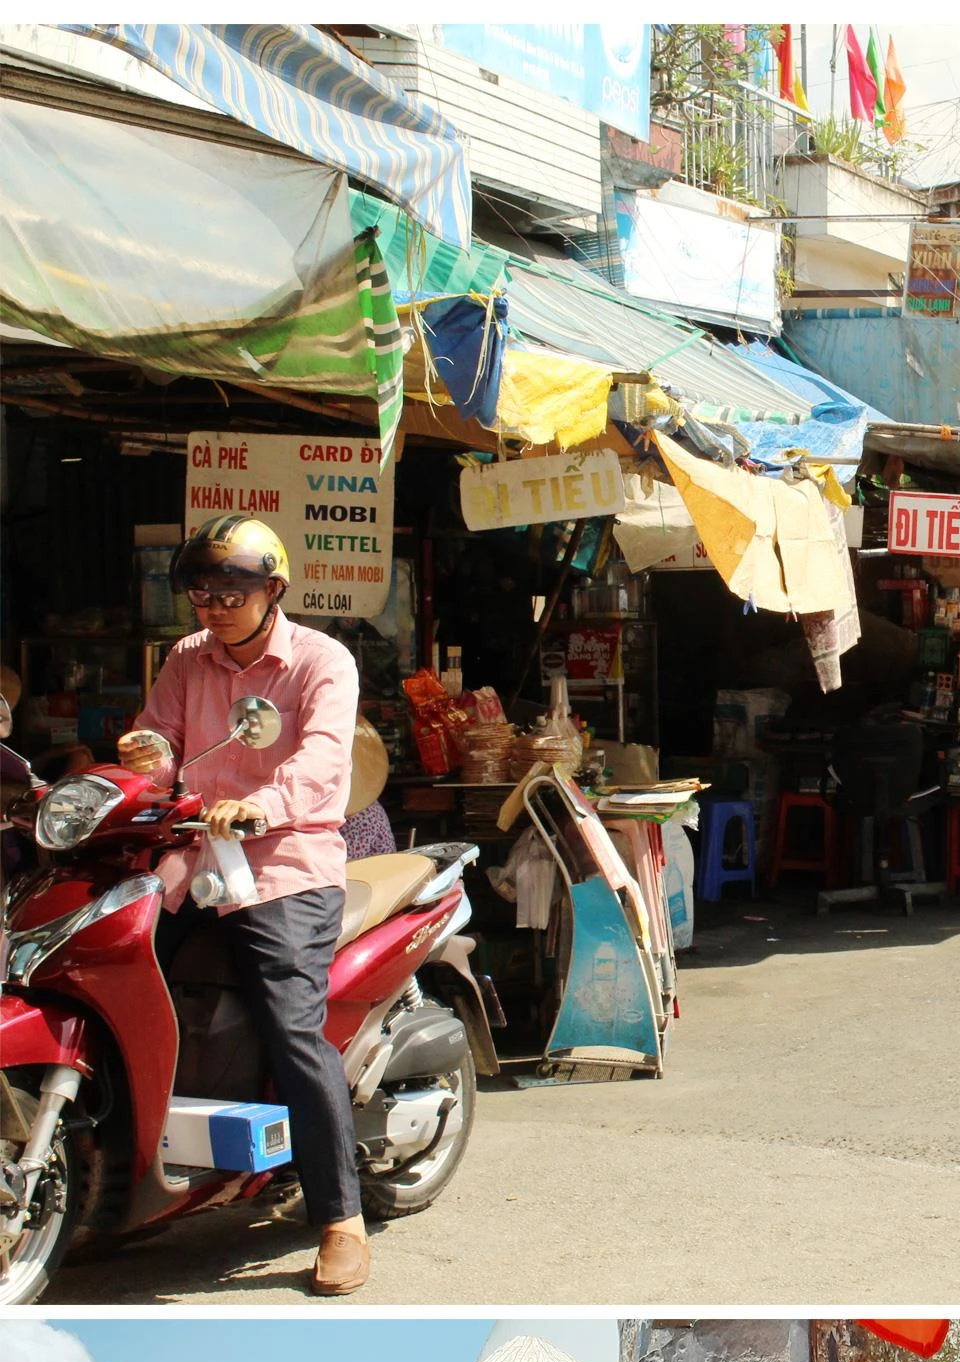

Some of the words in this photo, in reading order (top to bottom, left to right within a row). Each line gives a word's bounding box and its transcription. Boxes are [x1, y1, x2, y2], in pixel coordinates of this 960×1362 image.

[602, 76, 639, 113] pepsi
[192, 440, 212, 468] CÀ
[218, 441, 249, 470] PHÊ
[299, 444, 353, 463] CARD
[306, 474, 378, 493] VINA
[191, 482, 234, 511] KHĂN
[238, 489, 280, 516] LẠNH
[305, 504, 377, 524] MOBI
[895, 507, 919, 548] ĐI
[304, 534, 382, 553] VIETTEL
[304, 560, 328, 583] VIỆT
[331, 563, 354, 583] NAM
[357, 565, 384, 583] MOBI
[303, 589, 325, 610] CÁC
[327, 594, 352, 614] LOẠI
